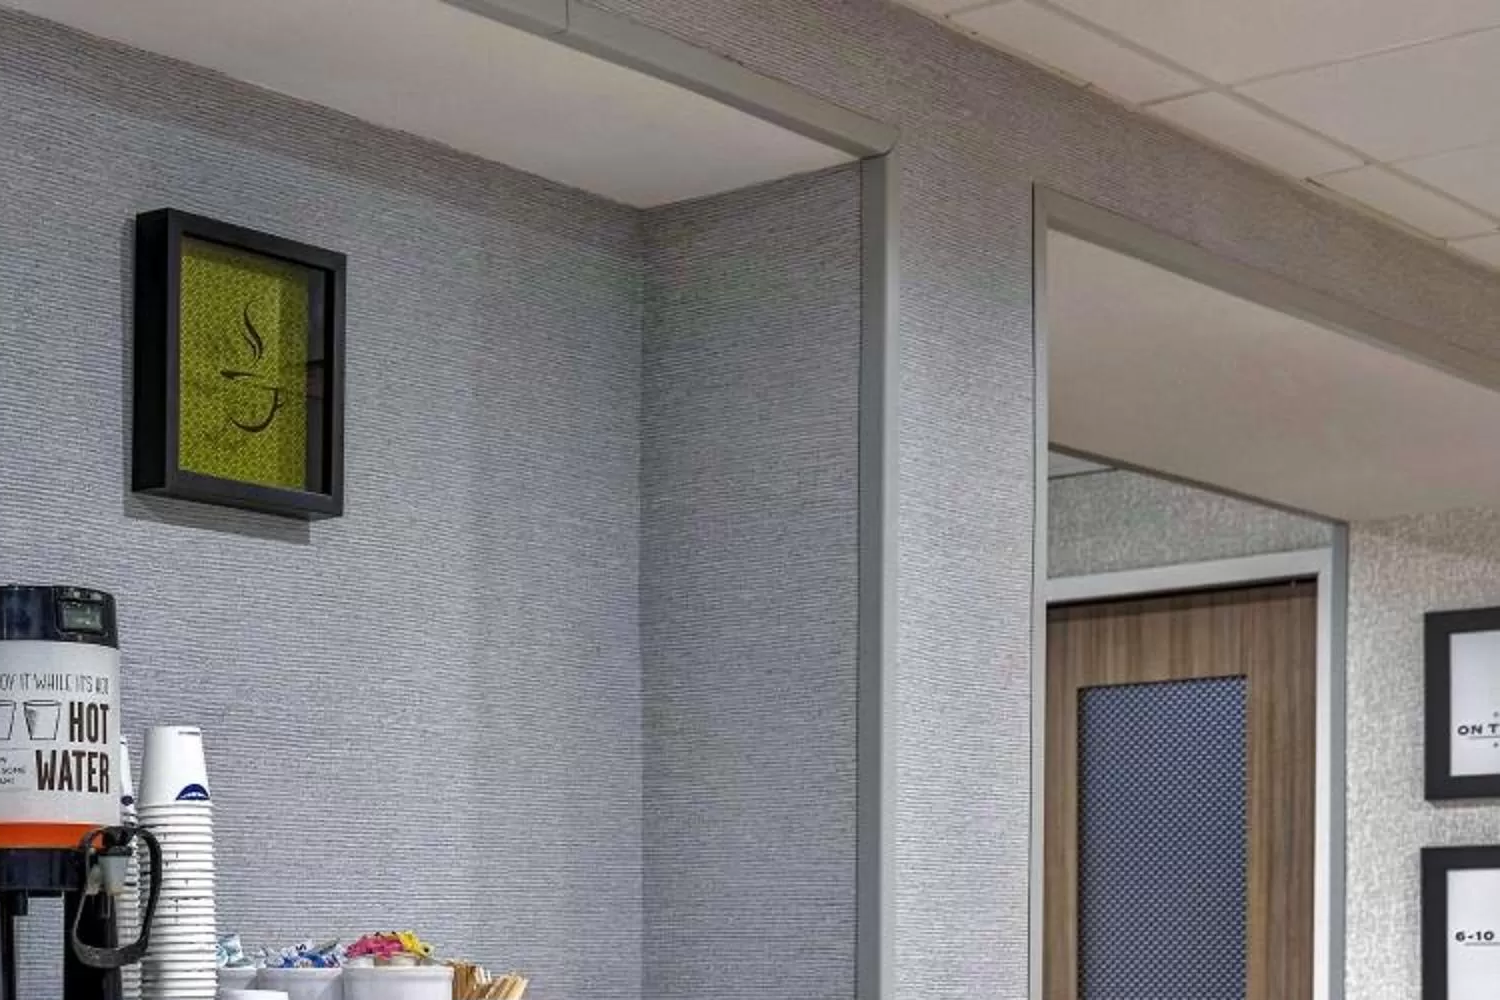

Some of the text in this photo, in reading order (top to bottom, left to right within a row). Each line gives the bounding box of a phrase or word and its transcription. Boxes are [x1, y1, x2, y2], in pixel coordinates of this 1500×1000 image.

[33, 673, 71, 691] WHILE
[69, 701, 110, 744] HOT
[1457, 724, 1483, 736] ON
[35, 750, 110, 794] WATER
[1455, 931, 1495, 942] 6-10
